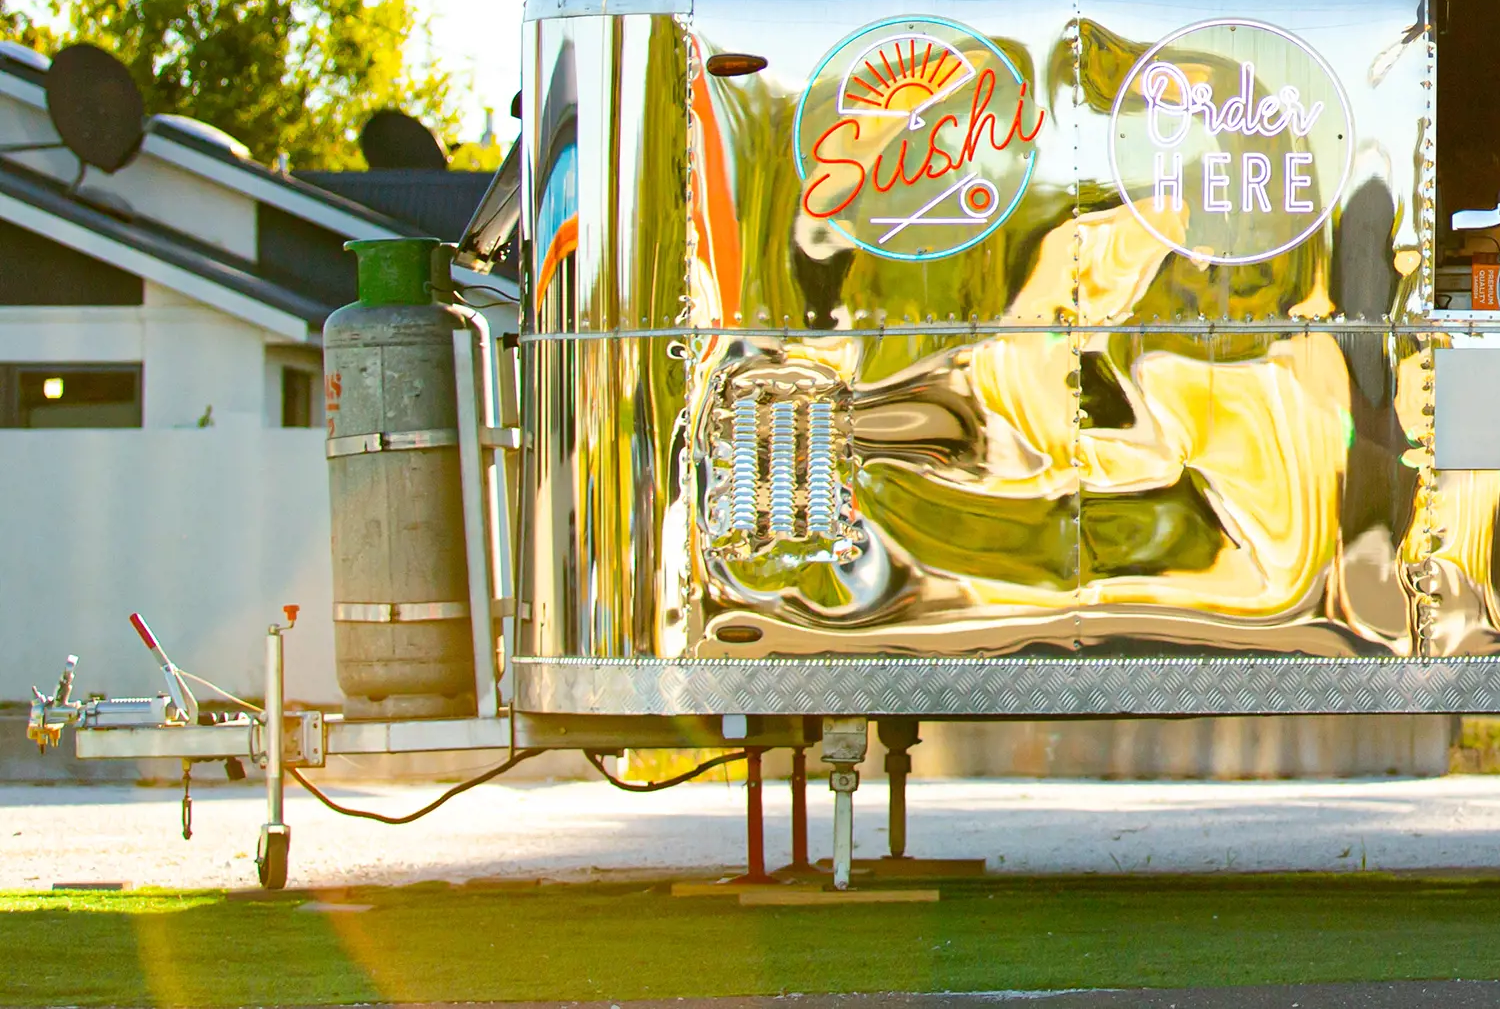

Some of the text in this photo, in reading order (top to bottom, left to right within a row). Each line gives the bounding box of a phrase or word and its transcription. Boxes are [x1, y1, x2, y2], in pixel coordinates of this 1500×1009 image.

[1140, 61, 1325, 149] Order
[803, 67, 1045, 219] Sushi
[1153, 152, 1315, 213] HERE
[1487, 269, 1495, 305] PREMIUM
